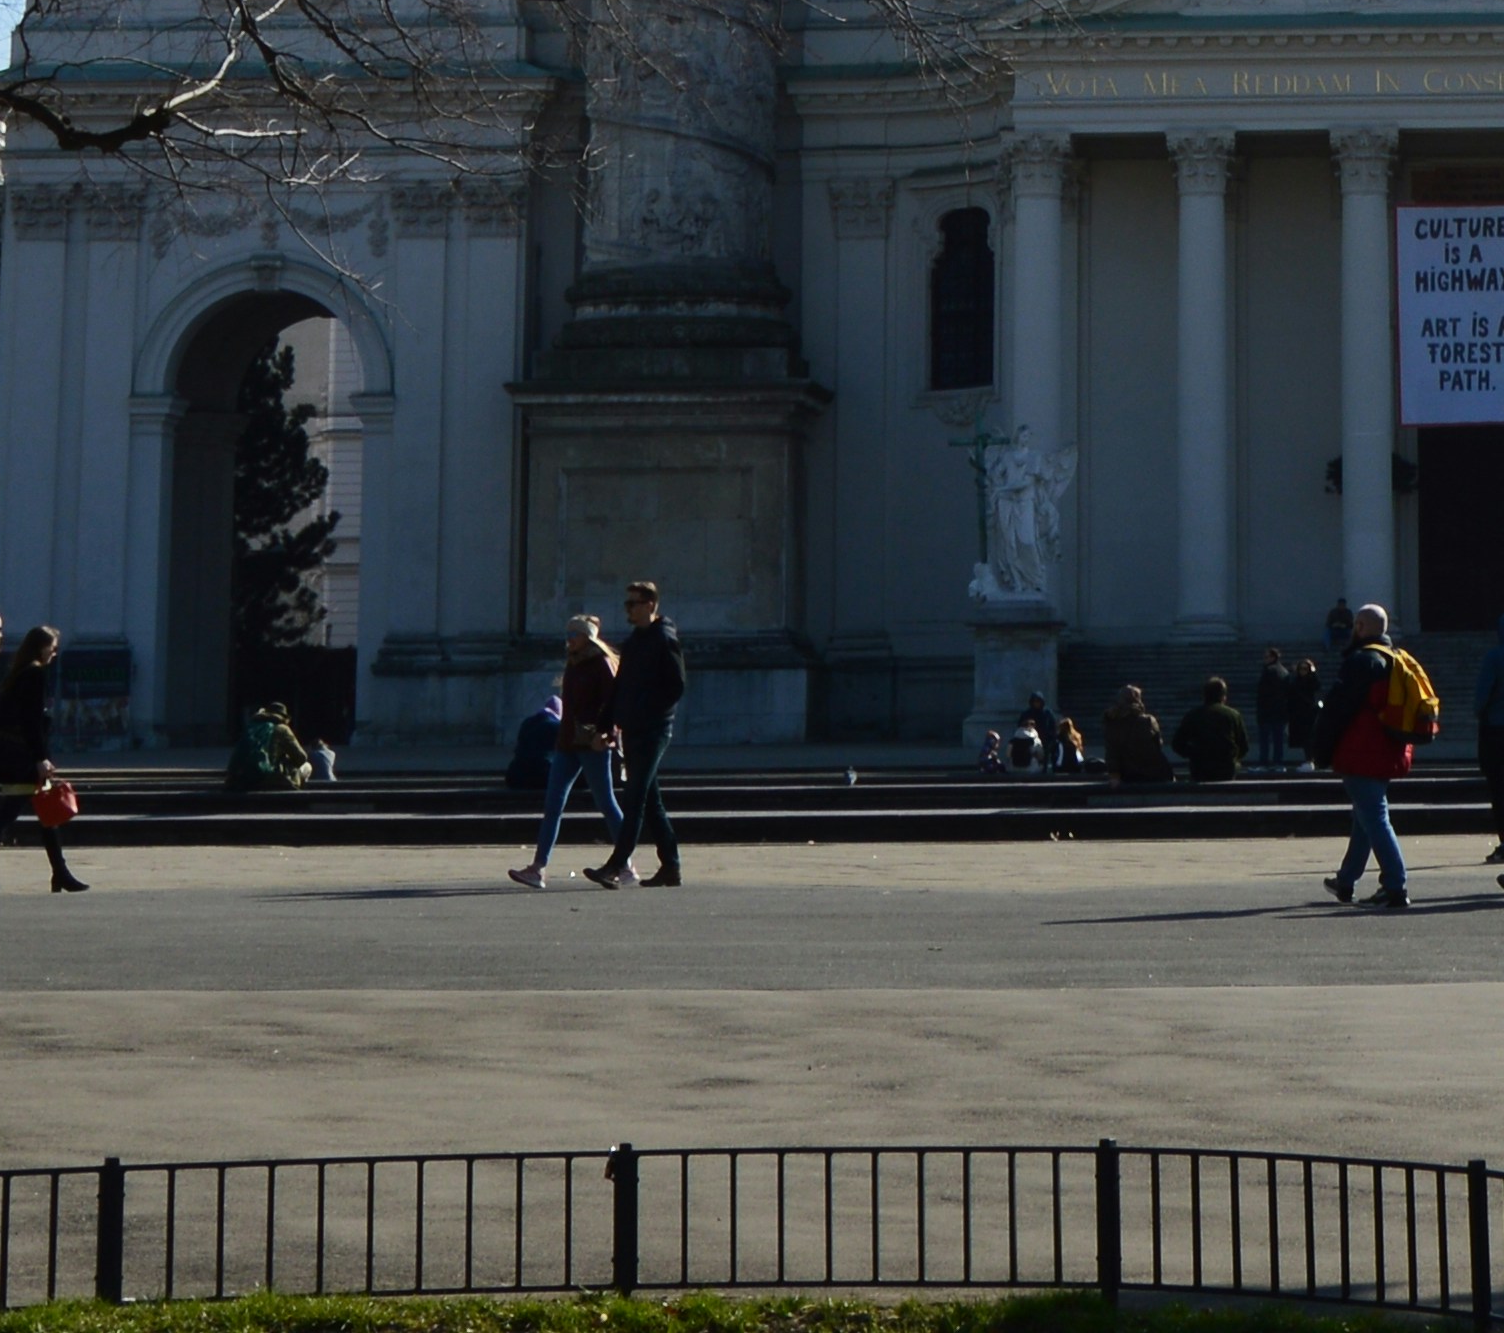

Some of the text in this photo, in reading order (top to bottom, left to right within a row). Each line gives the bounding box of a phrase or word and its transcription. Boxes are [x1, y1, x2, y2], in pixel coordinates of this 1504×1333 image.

[1046, 71, 1118, 96] VOTA
[1144, 71, 1208, 95] MEA
[1232, 69, 1351, 96] REDDAM
[1375, 68, 1400, 93] IN
[1468, 244, 1483, 263] A
[1421, 317, 1461, 338] ART
[1439, 370, 1496, 392] PATH.
